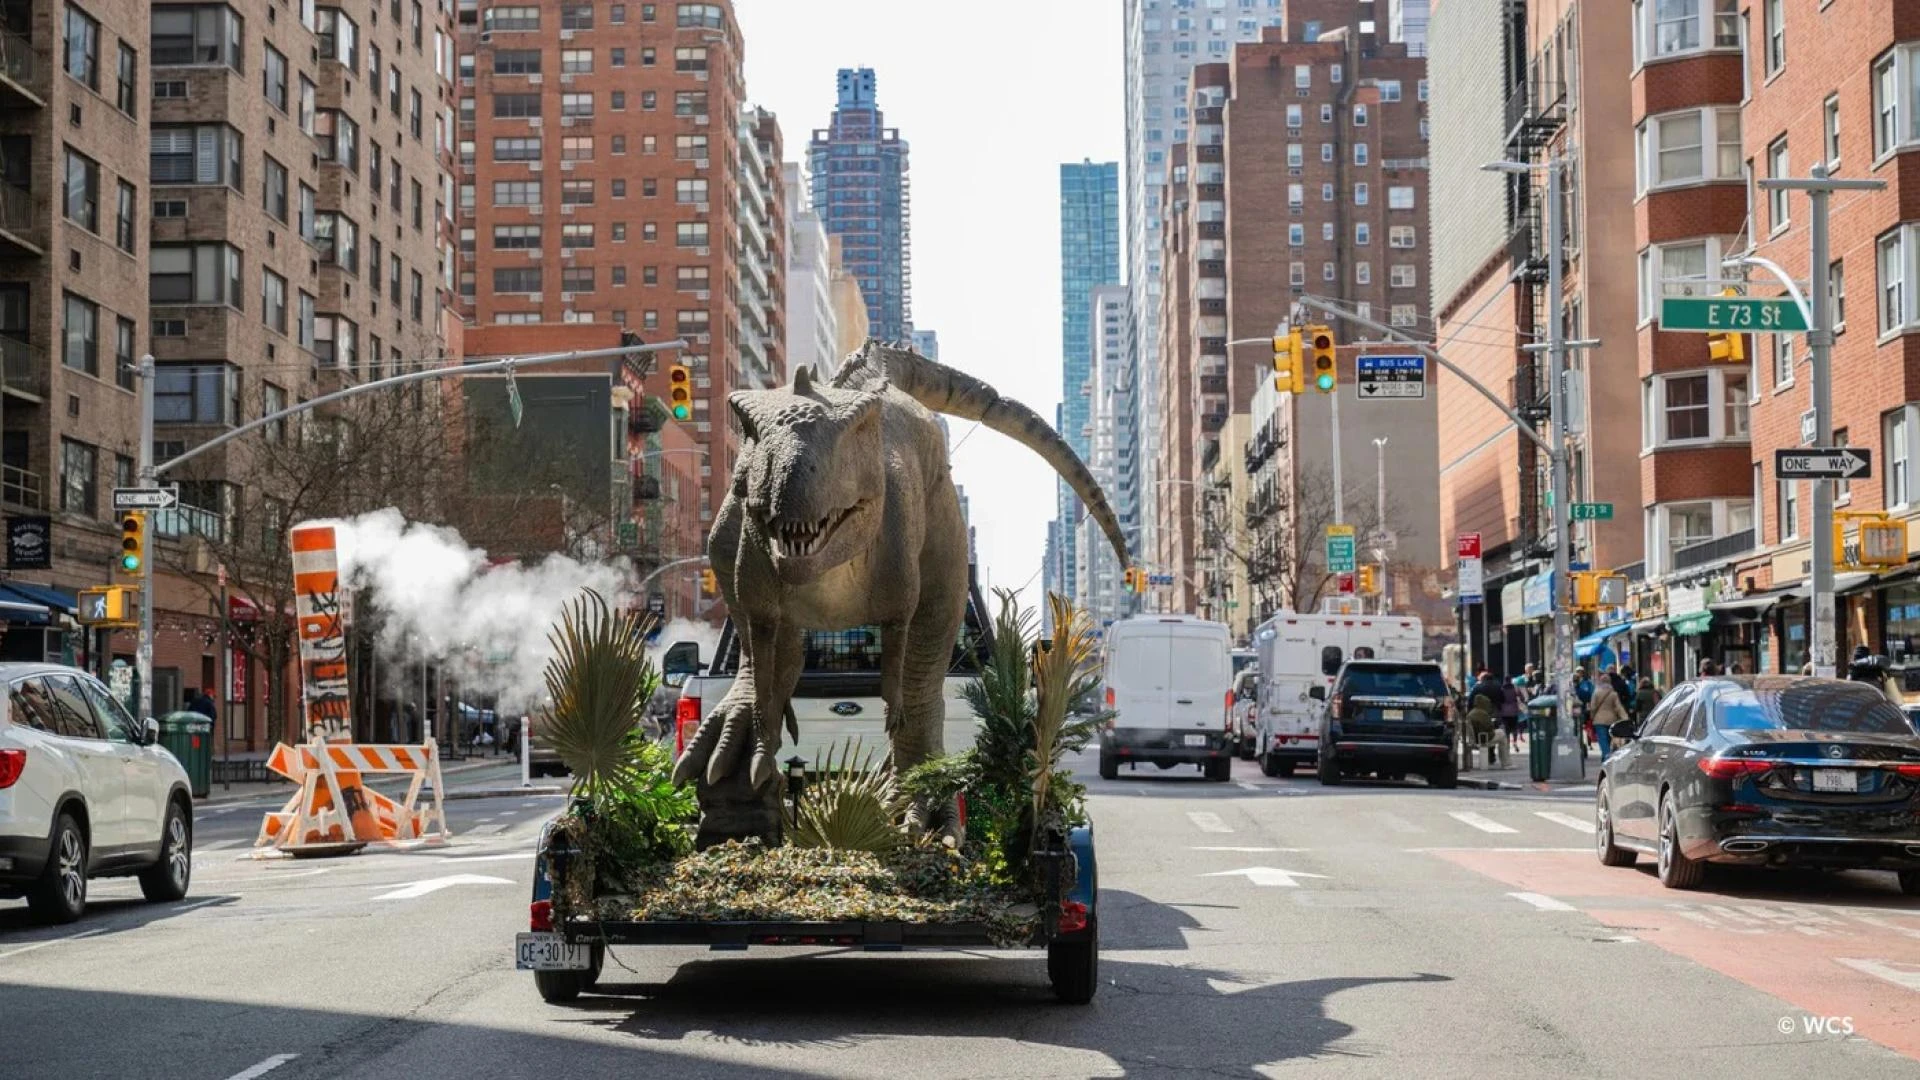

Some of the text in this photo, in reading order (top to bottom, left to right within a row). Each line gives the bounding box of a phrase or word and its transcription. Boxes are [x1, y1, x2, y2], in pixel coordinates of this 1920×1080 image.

[1708, 305, 1782, 325] E 73 St
[1379, 359, 1419, 367] BUS LANE
[1785, 458, 1855, 470] ONE WAY
[118, 495, 169, 503] ONE WAY
[1575, 505, 1581, 518] E
[1585, 505, 1596, 518] 73
